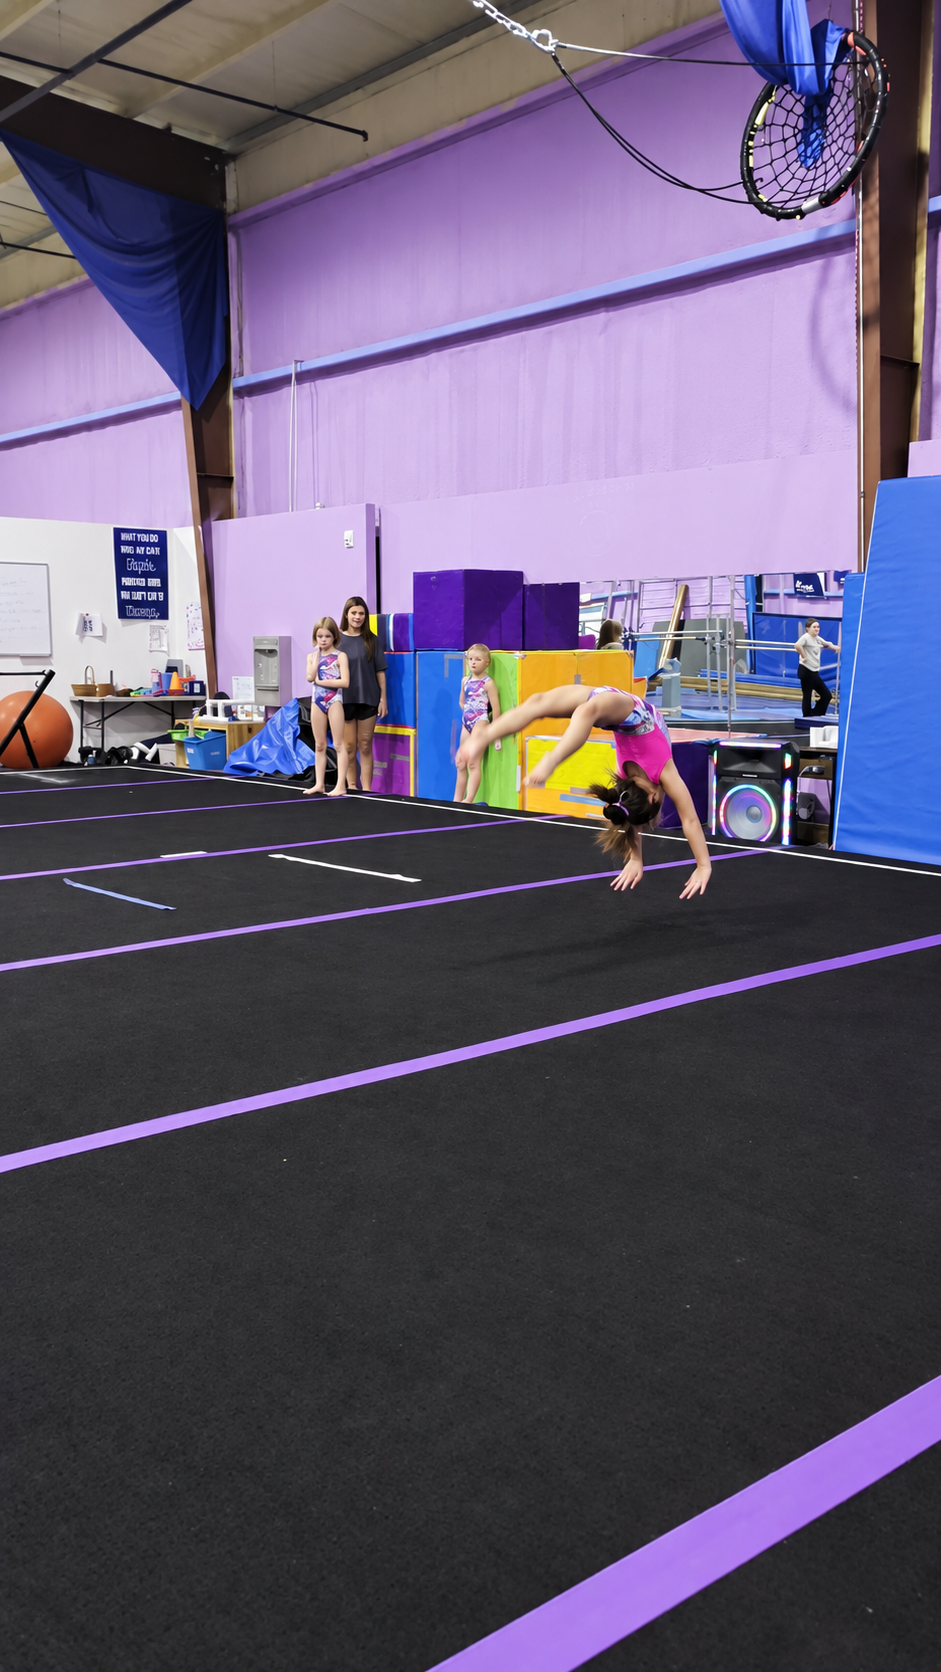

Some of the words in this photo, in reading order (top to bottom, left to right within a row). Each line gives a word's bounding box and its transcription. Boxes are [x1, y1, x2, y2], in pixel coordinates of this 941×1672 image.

[120, 532, 136, 541] WHAT
[137, 533, 149, 542] YOU
[150, 534, 159, 543] DO
